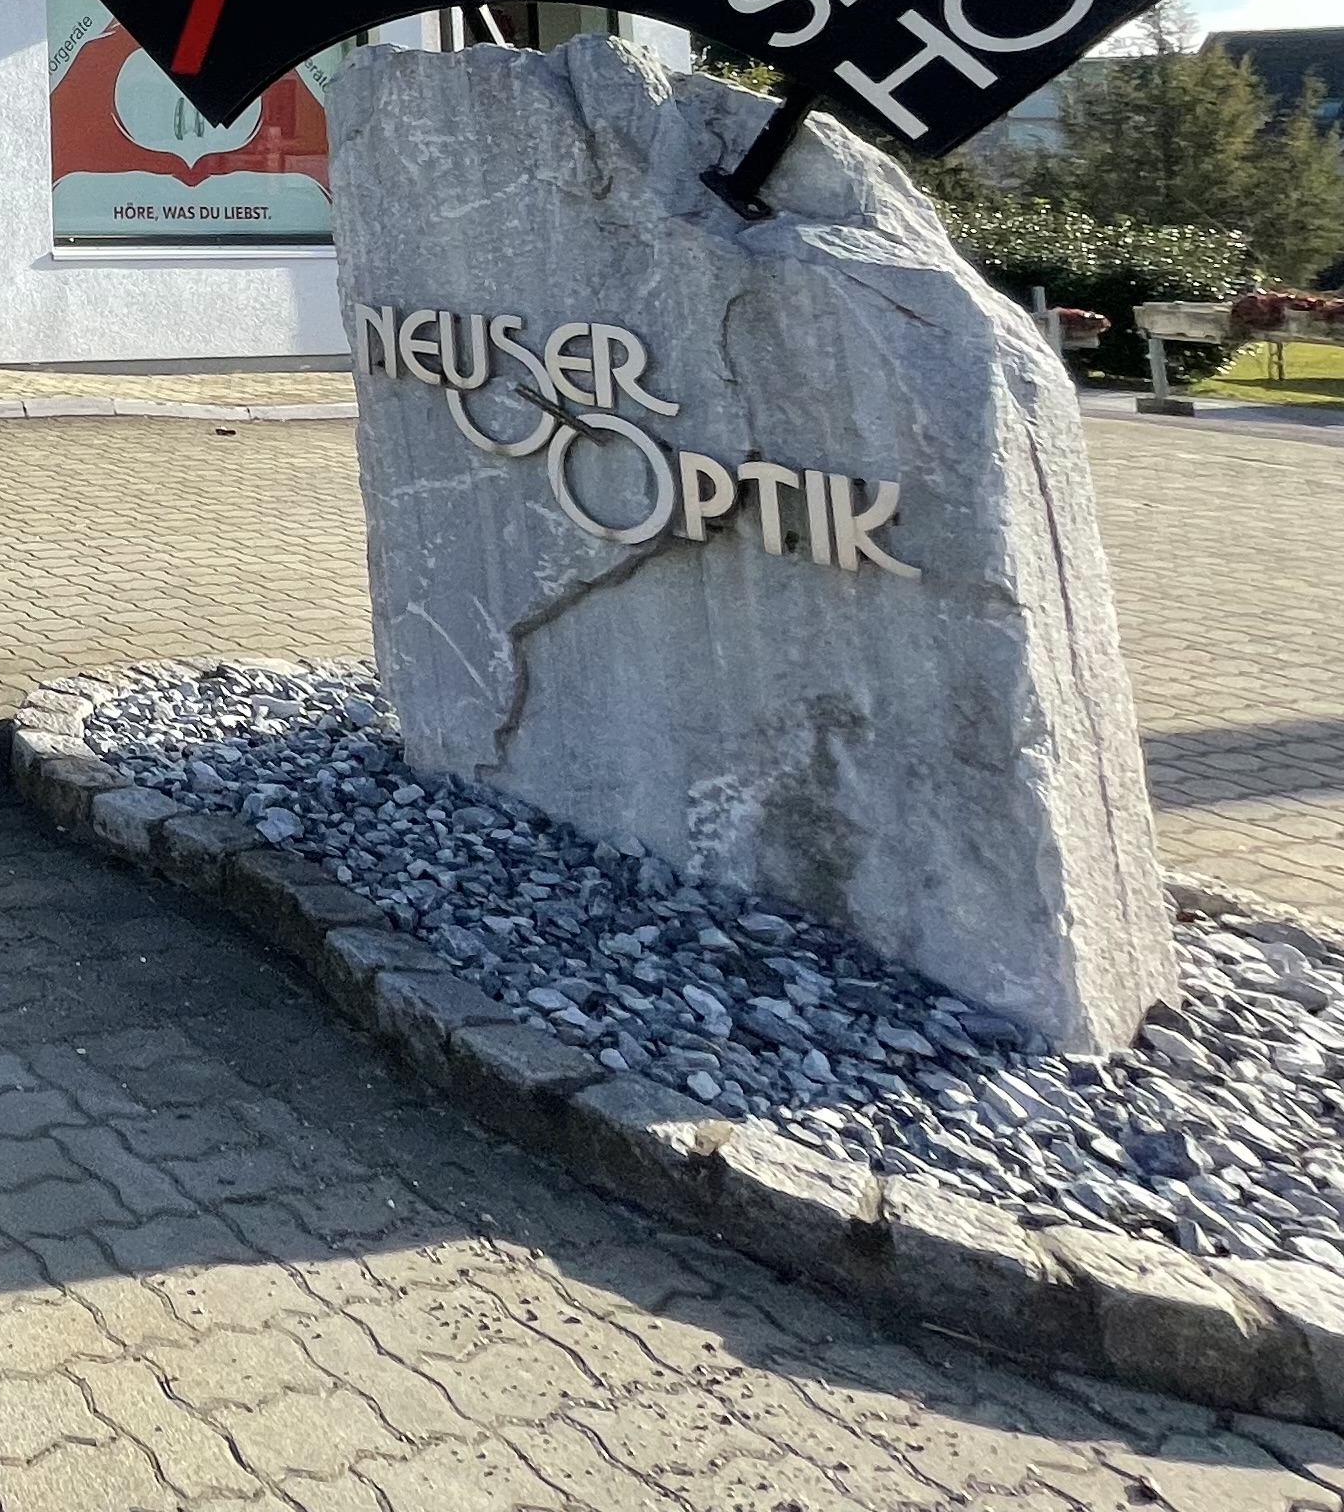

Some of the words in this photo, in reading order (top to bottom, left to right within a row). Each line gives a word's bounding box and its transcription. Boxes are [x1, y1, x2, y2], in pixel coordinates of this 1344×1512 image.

[48, 15, 94, 76] örgeräte
[113, 202, 159, 222] HÖRE,
[162, 205, 196, 220] WAS
[199, 205, 221, 220] DU
[224, 206, 273, 221] LIEBST.
[354, 303, 680, 458] NEUSER
[547, 412, 923, 579] OPTIK
